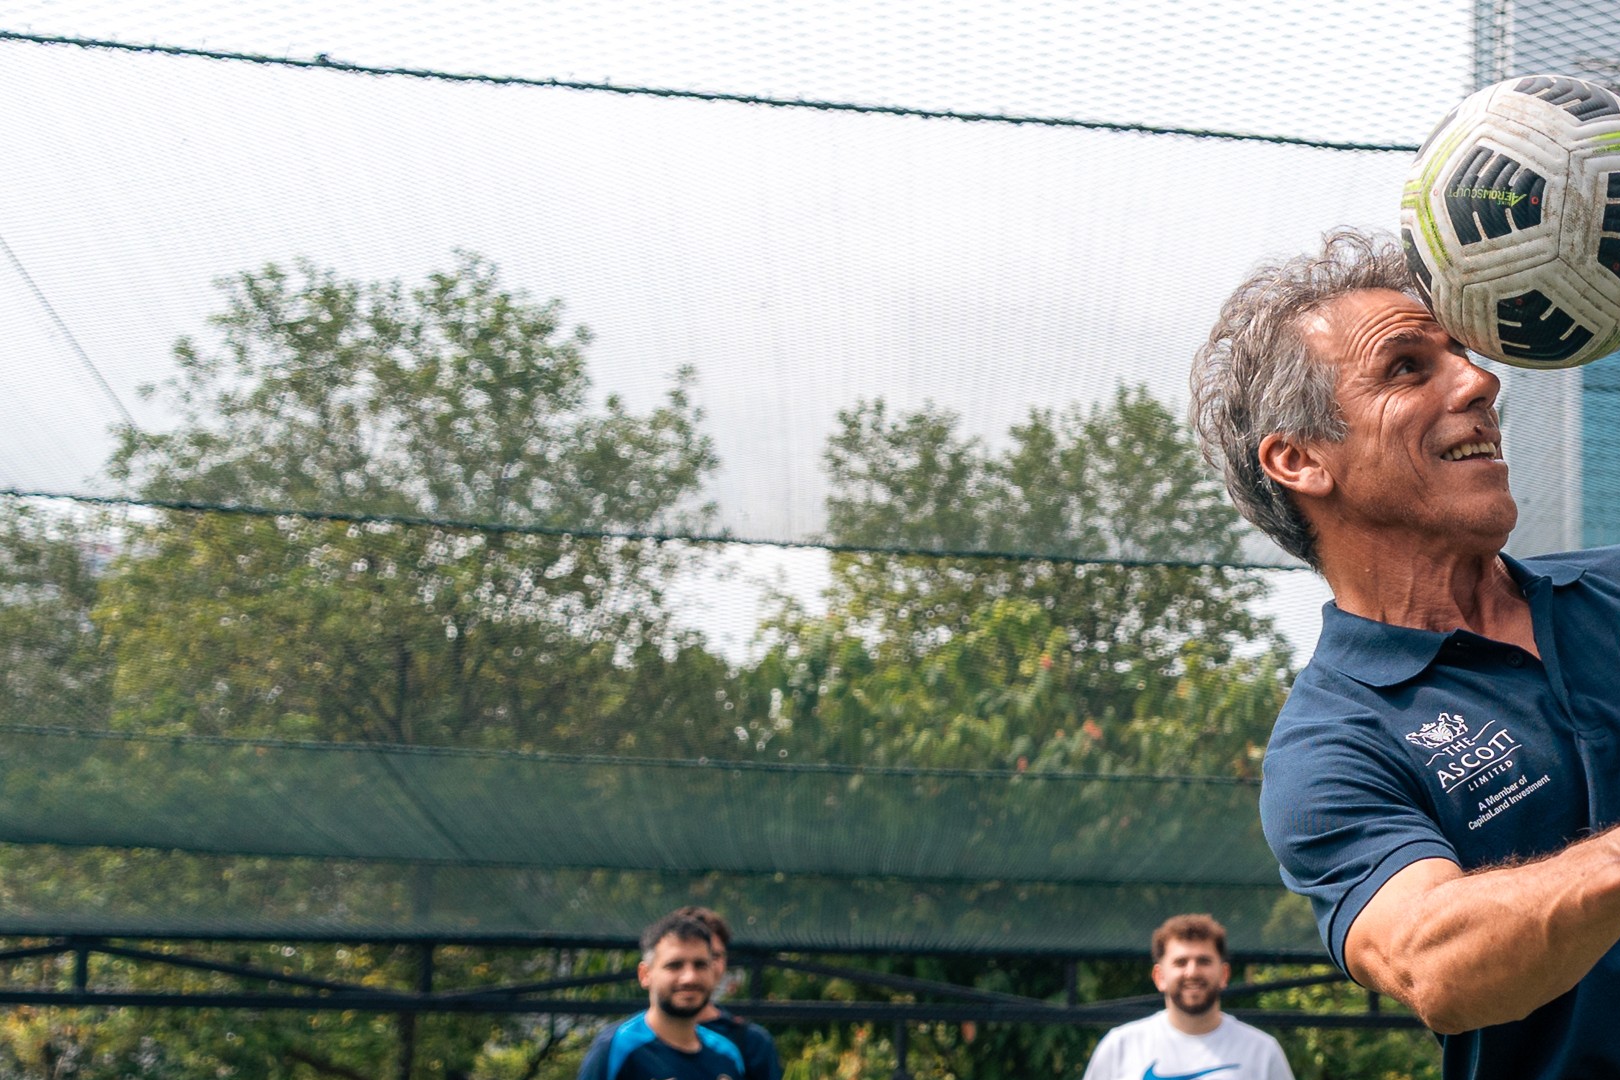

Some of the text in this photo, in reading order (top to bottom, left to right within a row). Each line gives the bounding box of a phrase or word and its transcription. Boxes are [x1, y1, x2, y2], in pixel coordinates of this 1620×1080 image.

[1436, 729, 1515, 789] ASCOTT
[1442, 737, 1475, 757] THE
[1467, 759, 1514, 792] LIMITED
[1478, 774, 1528, 812] A Member of
[1468, 774, 1551, 831] CapitaLand Investment
